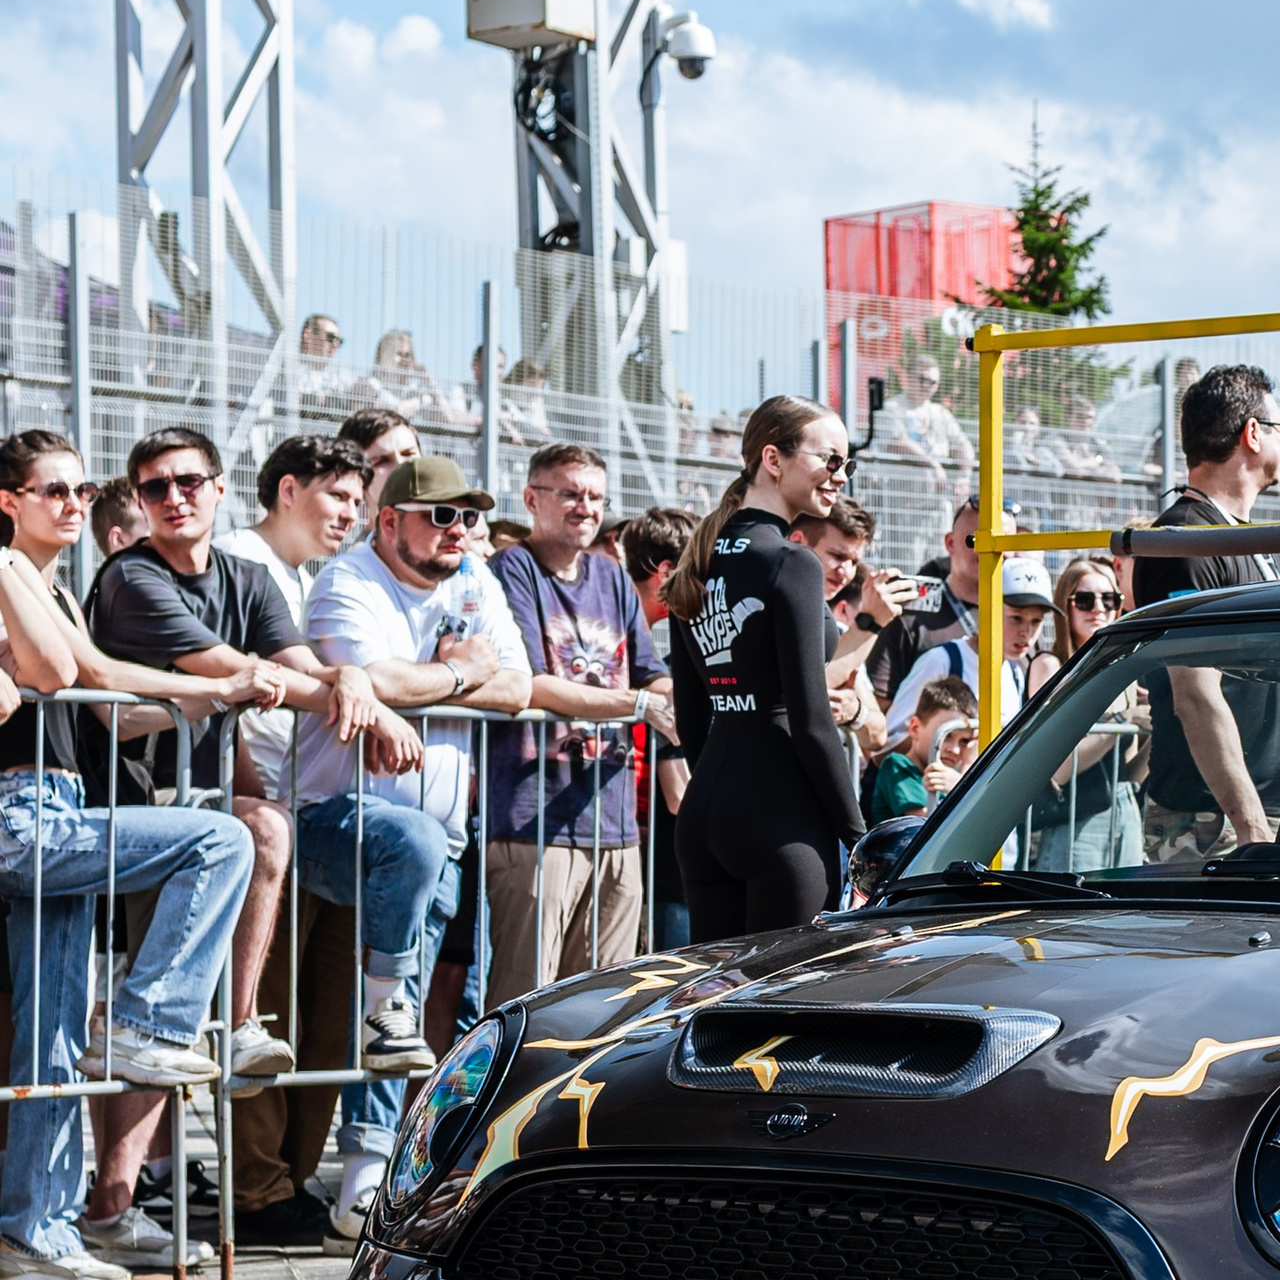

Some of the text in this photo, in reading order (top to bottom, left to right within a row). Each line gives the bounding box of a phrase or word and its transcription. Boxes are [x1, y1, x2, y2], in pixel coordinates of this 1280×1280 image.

[714, 538, 751, 554] RLS
[690, 611, 738, 656] HYPE
[709, 694, 756, 712] TEAM
